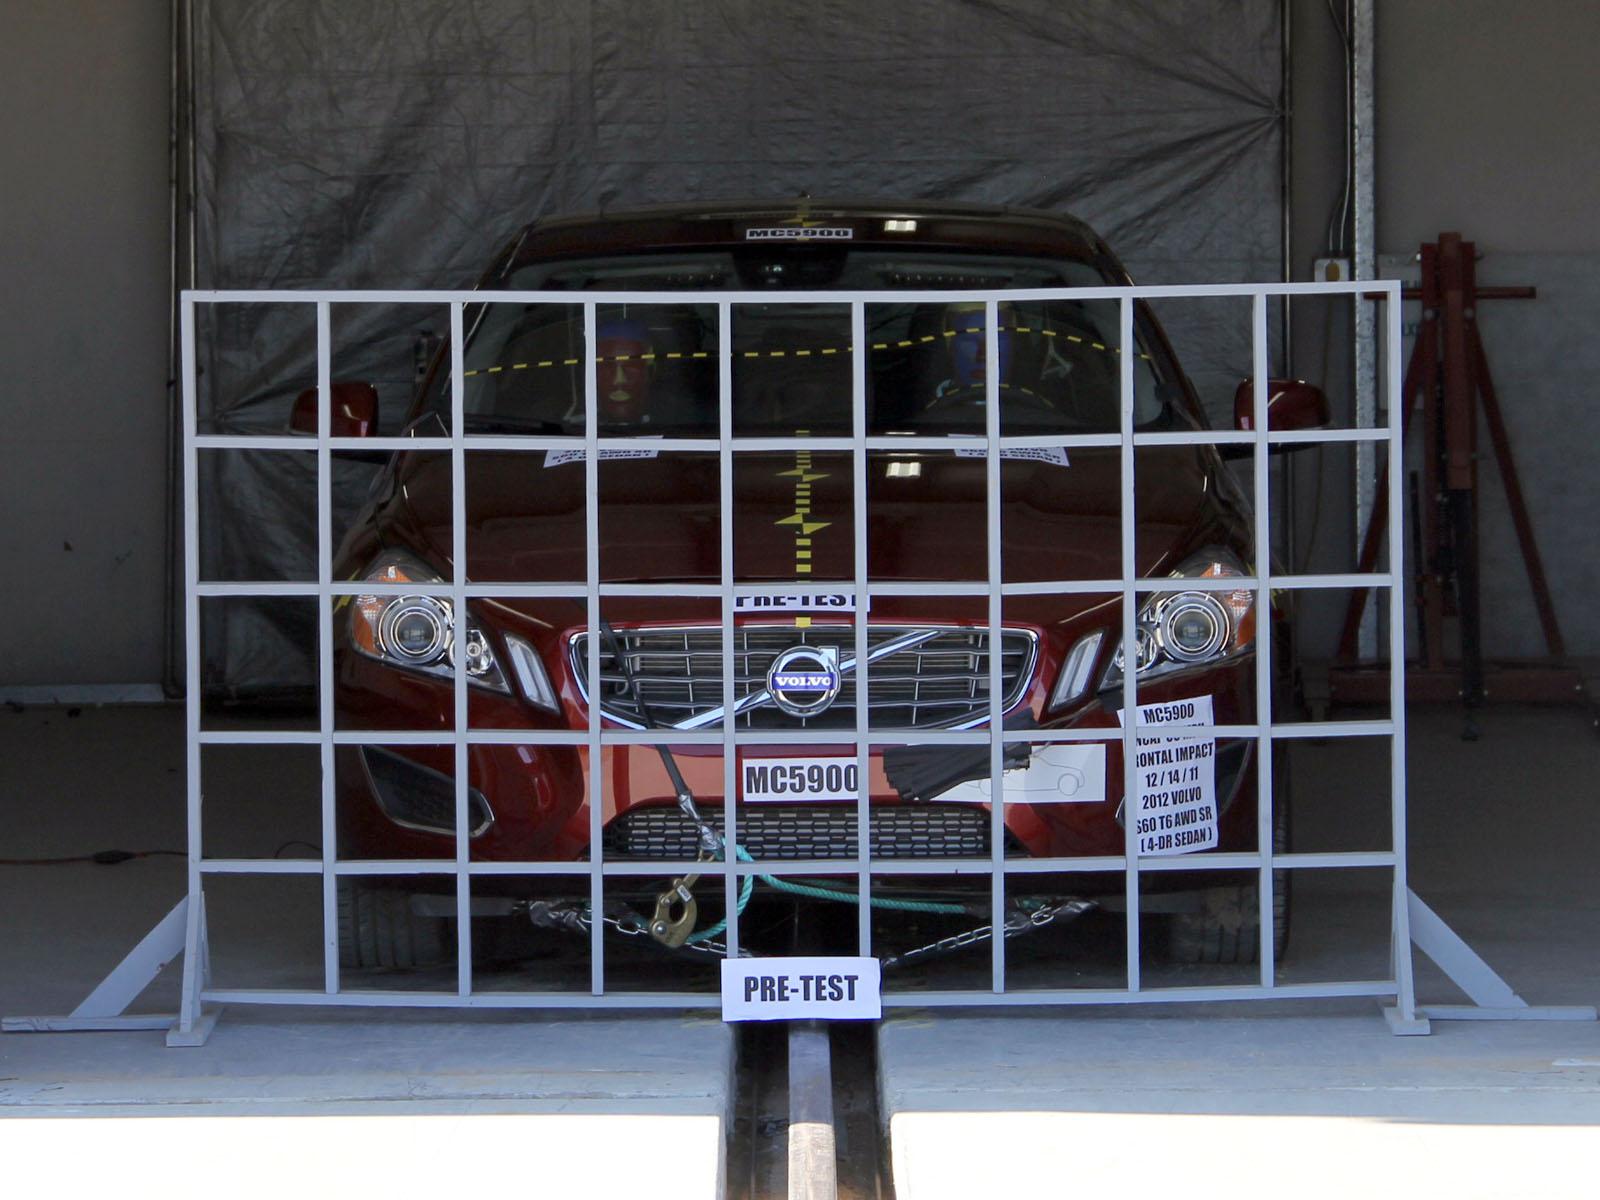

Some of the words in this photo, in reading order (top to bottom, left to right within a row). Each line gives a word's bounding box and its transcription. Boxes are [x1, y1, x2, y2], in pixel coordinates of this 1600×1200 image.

[750, 229, 849, 237] MC5900
[736, 595, 856, 607] PRE-TES
[774, 676, 832, 687] VOLVO
[1143, 703, 1194, 724] MC5900
[1175, 742, 1213, 762] IMPACT
[746, 764, 858, 794] MC5900
[1142, 792, 1169, 810] 2012
[1171, 786, 1201, 805] VOLVO
[1159, 814, 1173, 830] T6
[1174, 809, 1197, 827] AWD
[1198, 806, 1213, 822] SR
[1175, 827, 1206, 847] SEDAN
[744, 975, 859, 1002] PRE-TEST
